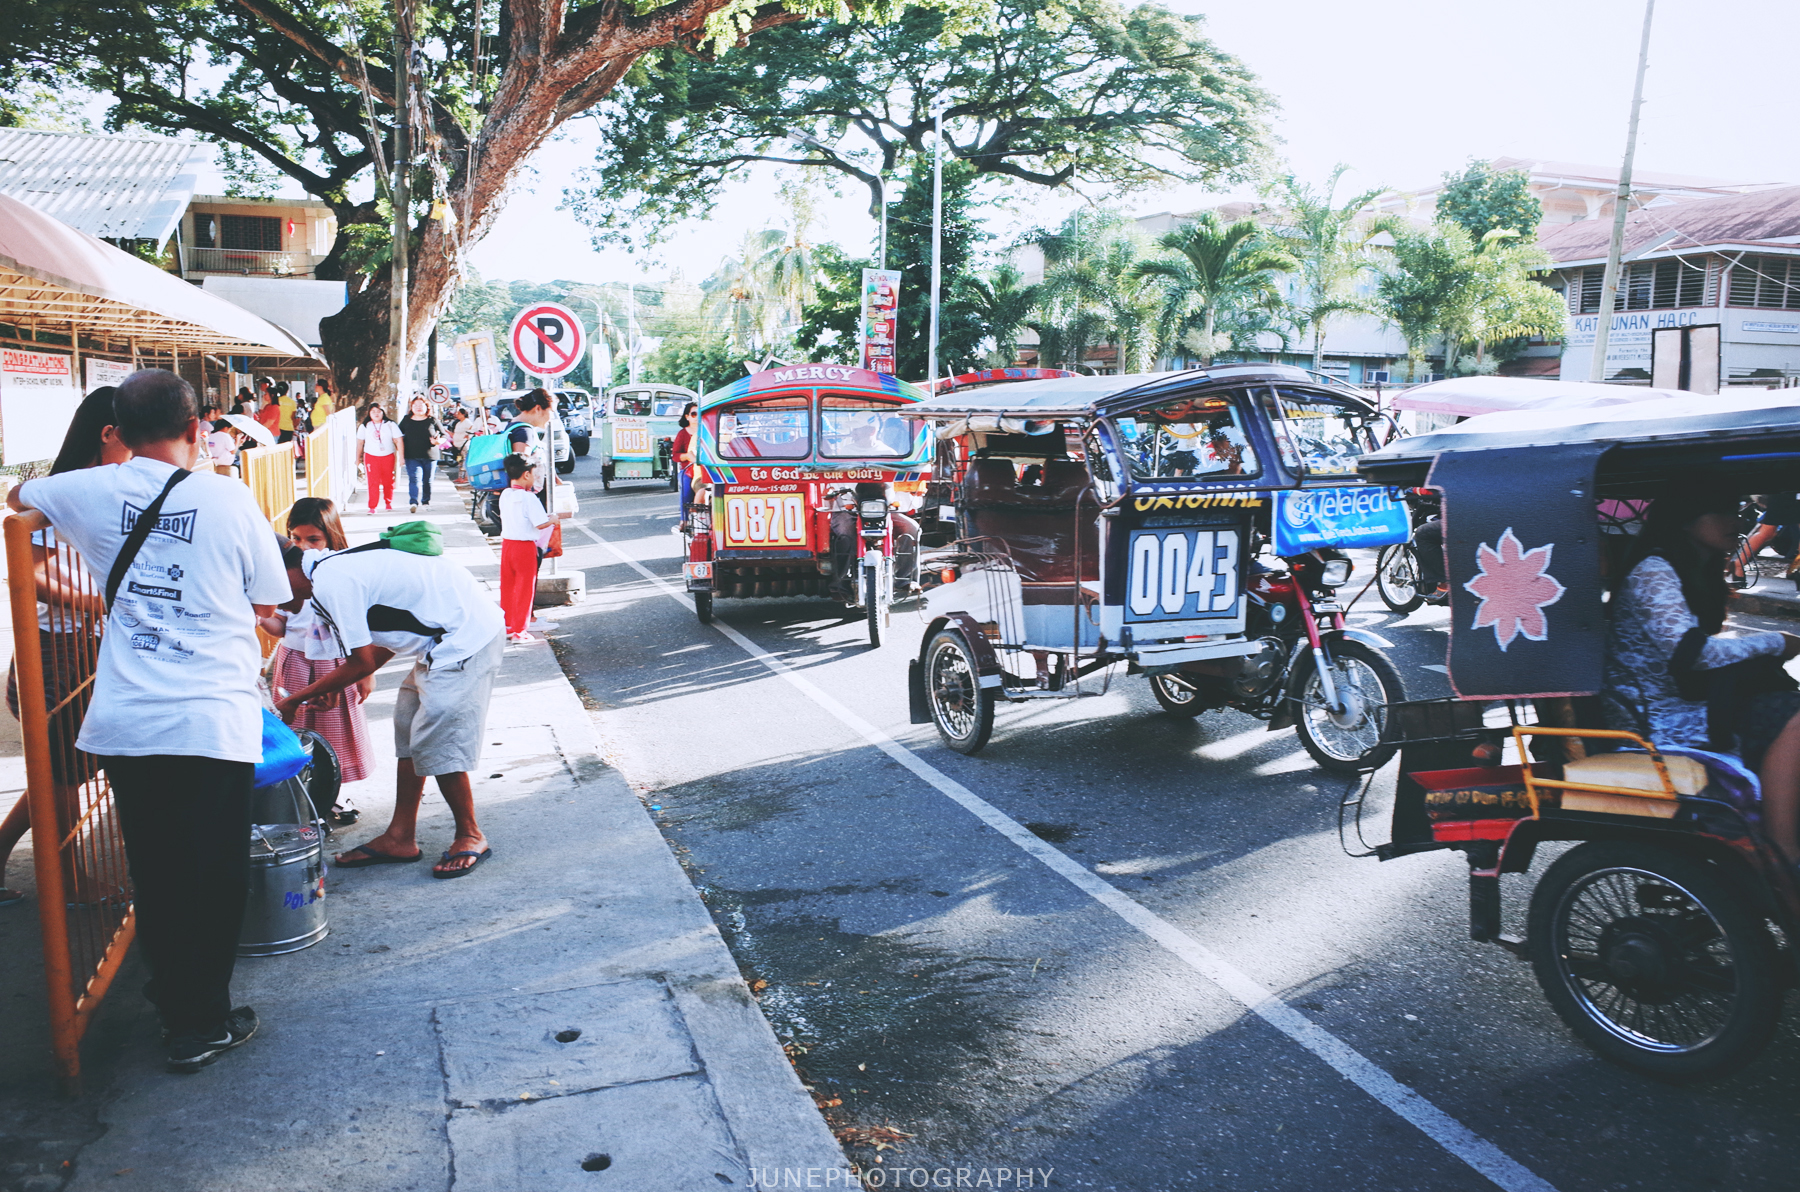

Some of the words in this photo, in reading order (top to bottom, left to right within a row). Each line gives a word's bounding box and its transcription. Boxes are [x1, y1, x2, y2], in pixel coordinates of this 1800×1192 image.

[1575, 314, 1650, 332] KATUNAN
[537, 317, 564, 364] P
[3, 351, 66, 369] CONGRATULATIONS
[773, 366, 857, 384] MERCY
[975, 371, 993, 380] THE
[1003, 368, 1023, 379] SON
[1026, 368, 1038, 378] OF
[434, 388, 444, 400] P
[617, 430, 648, 450] 1803
[750, 467, 768, 480] To
[771, 467, 800, 480] God
[846, 468, 883, 481] Glory
[1134, 484, 1263, 511] ORIGINAL
[1316, 487, 1393, 518] TeleTech
[126, 509, 191, 537] HEBOY
[727, 497, 804, 543] 0870
[1129, 530, 1239, 615] 0043
[132, 583, 178, 599] Smart&Final
